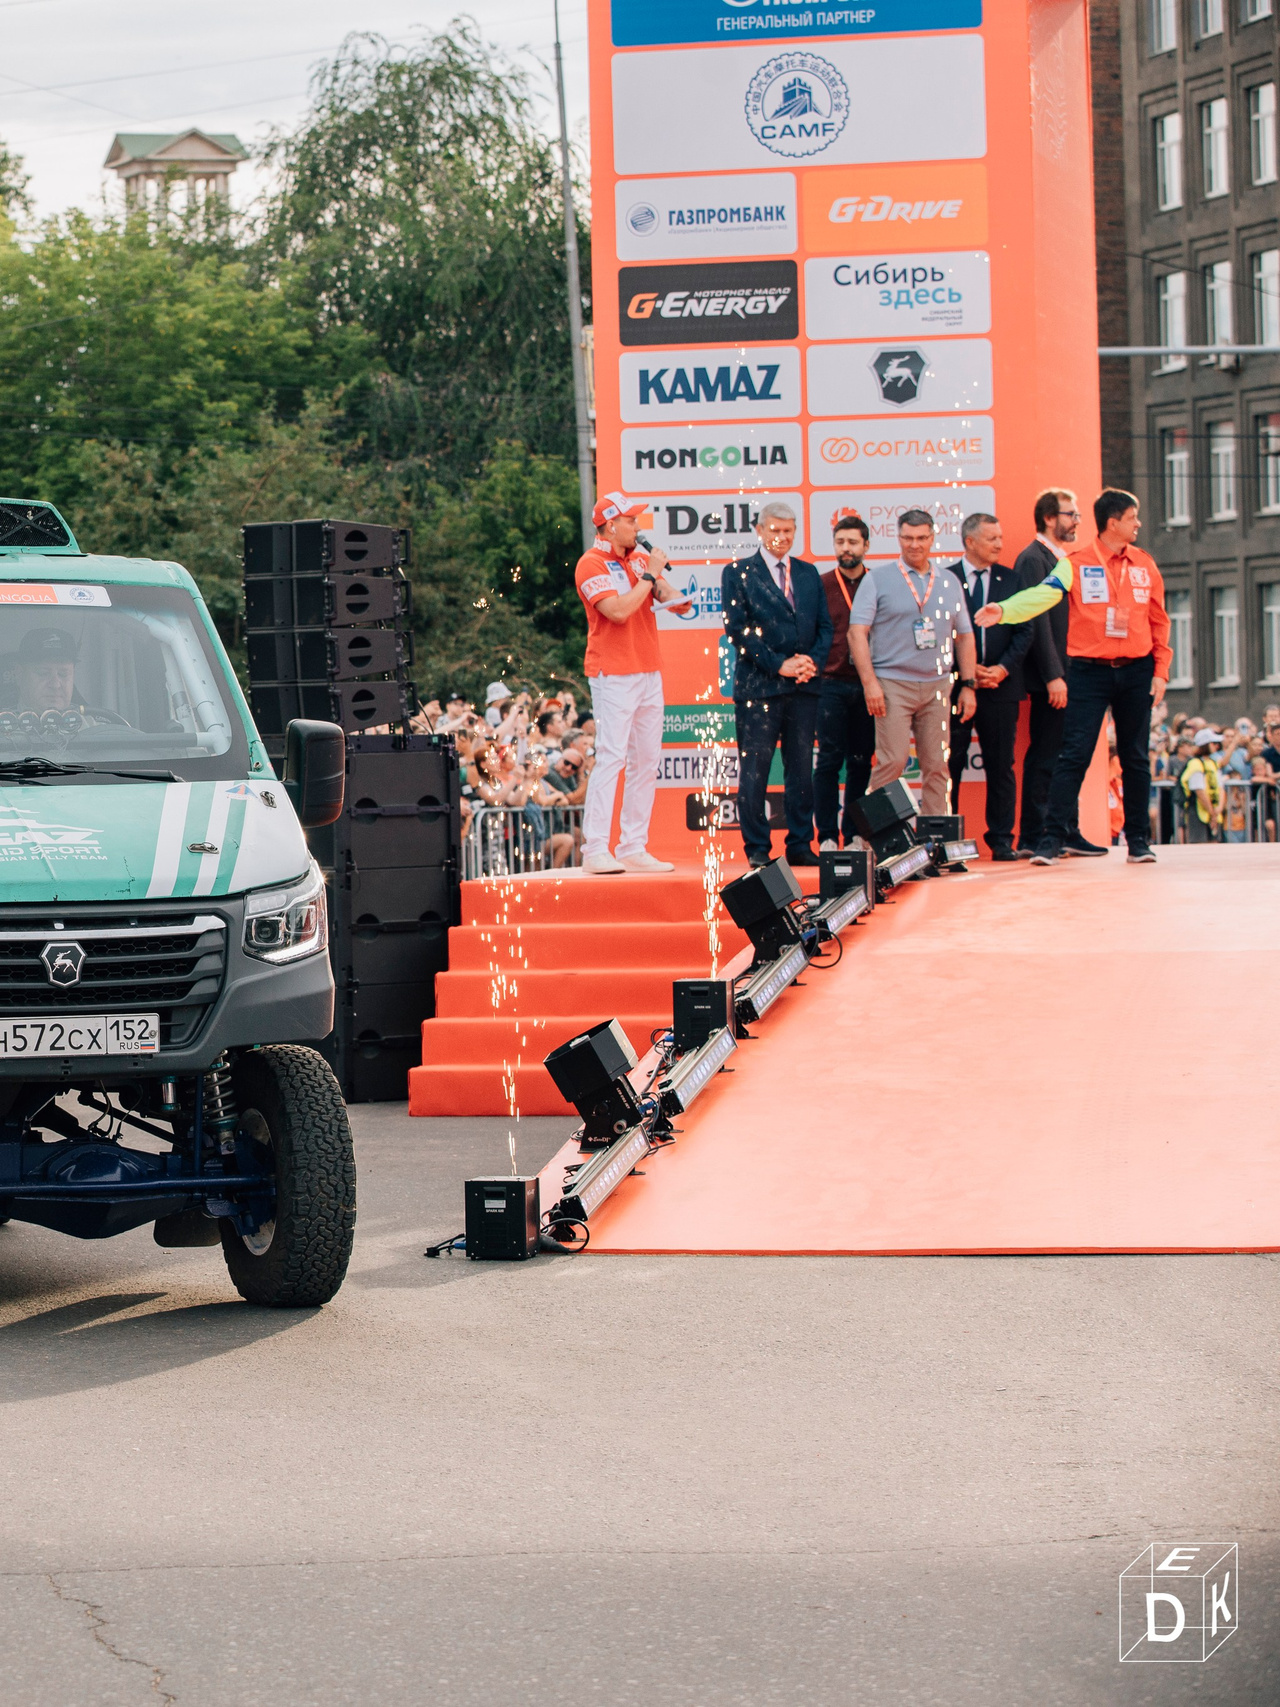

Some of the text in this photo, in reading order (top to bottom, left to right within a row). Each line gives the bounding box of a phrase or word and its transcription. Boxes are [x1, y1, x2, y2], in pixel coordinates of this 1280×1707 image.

[716, 9, 875, 31] ГЕНЕРАЛЬНЫЙ ПАРТНЕР
[761, 122, 835, 140] CAMF
[668, 205, 786, 226] ГАЗПРОМБАНК
[833, 262, 945, 289] Сибирь
[693, 287, 791, 298] МОТОРНОЕ МАСЛО
[879, 287, 962, 310] здесь
[639, 364, 781, 405] KAMAZ
[635, 445, 788, 469] MONGOLIA
[863, 438, 982, 457] СОГЛАСИЕ
[29, 846, 102, 854] SPORT
[109, 1019, 150, 1041] 152
[120, 1042, 140, 1050] RUS
